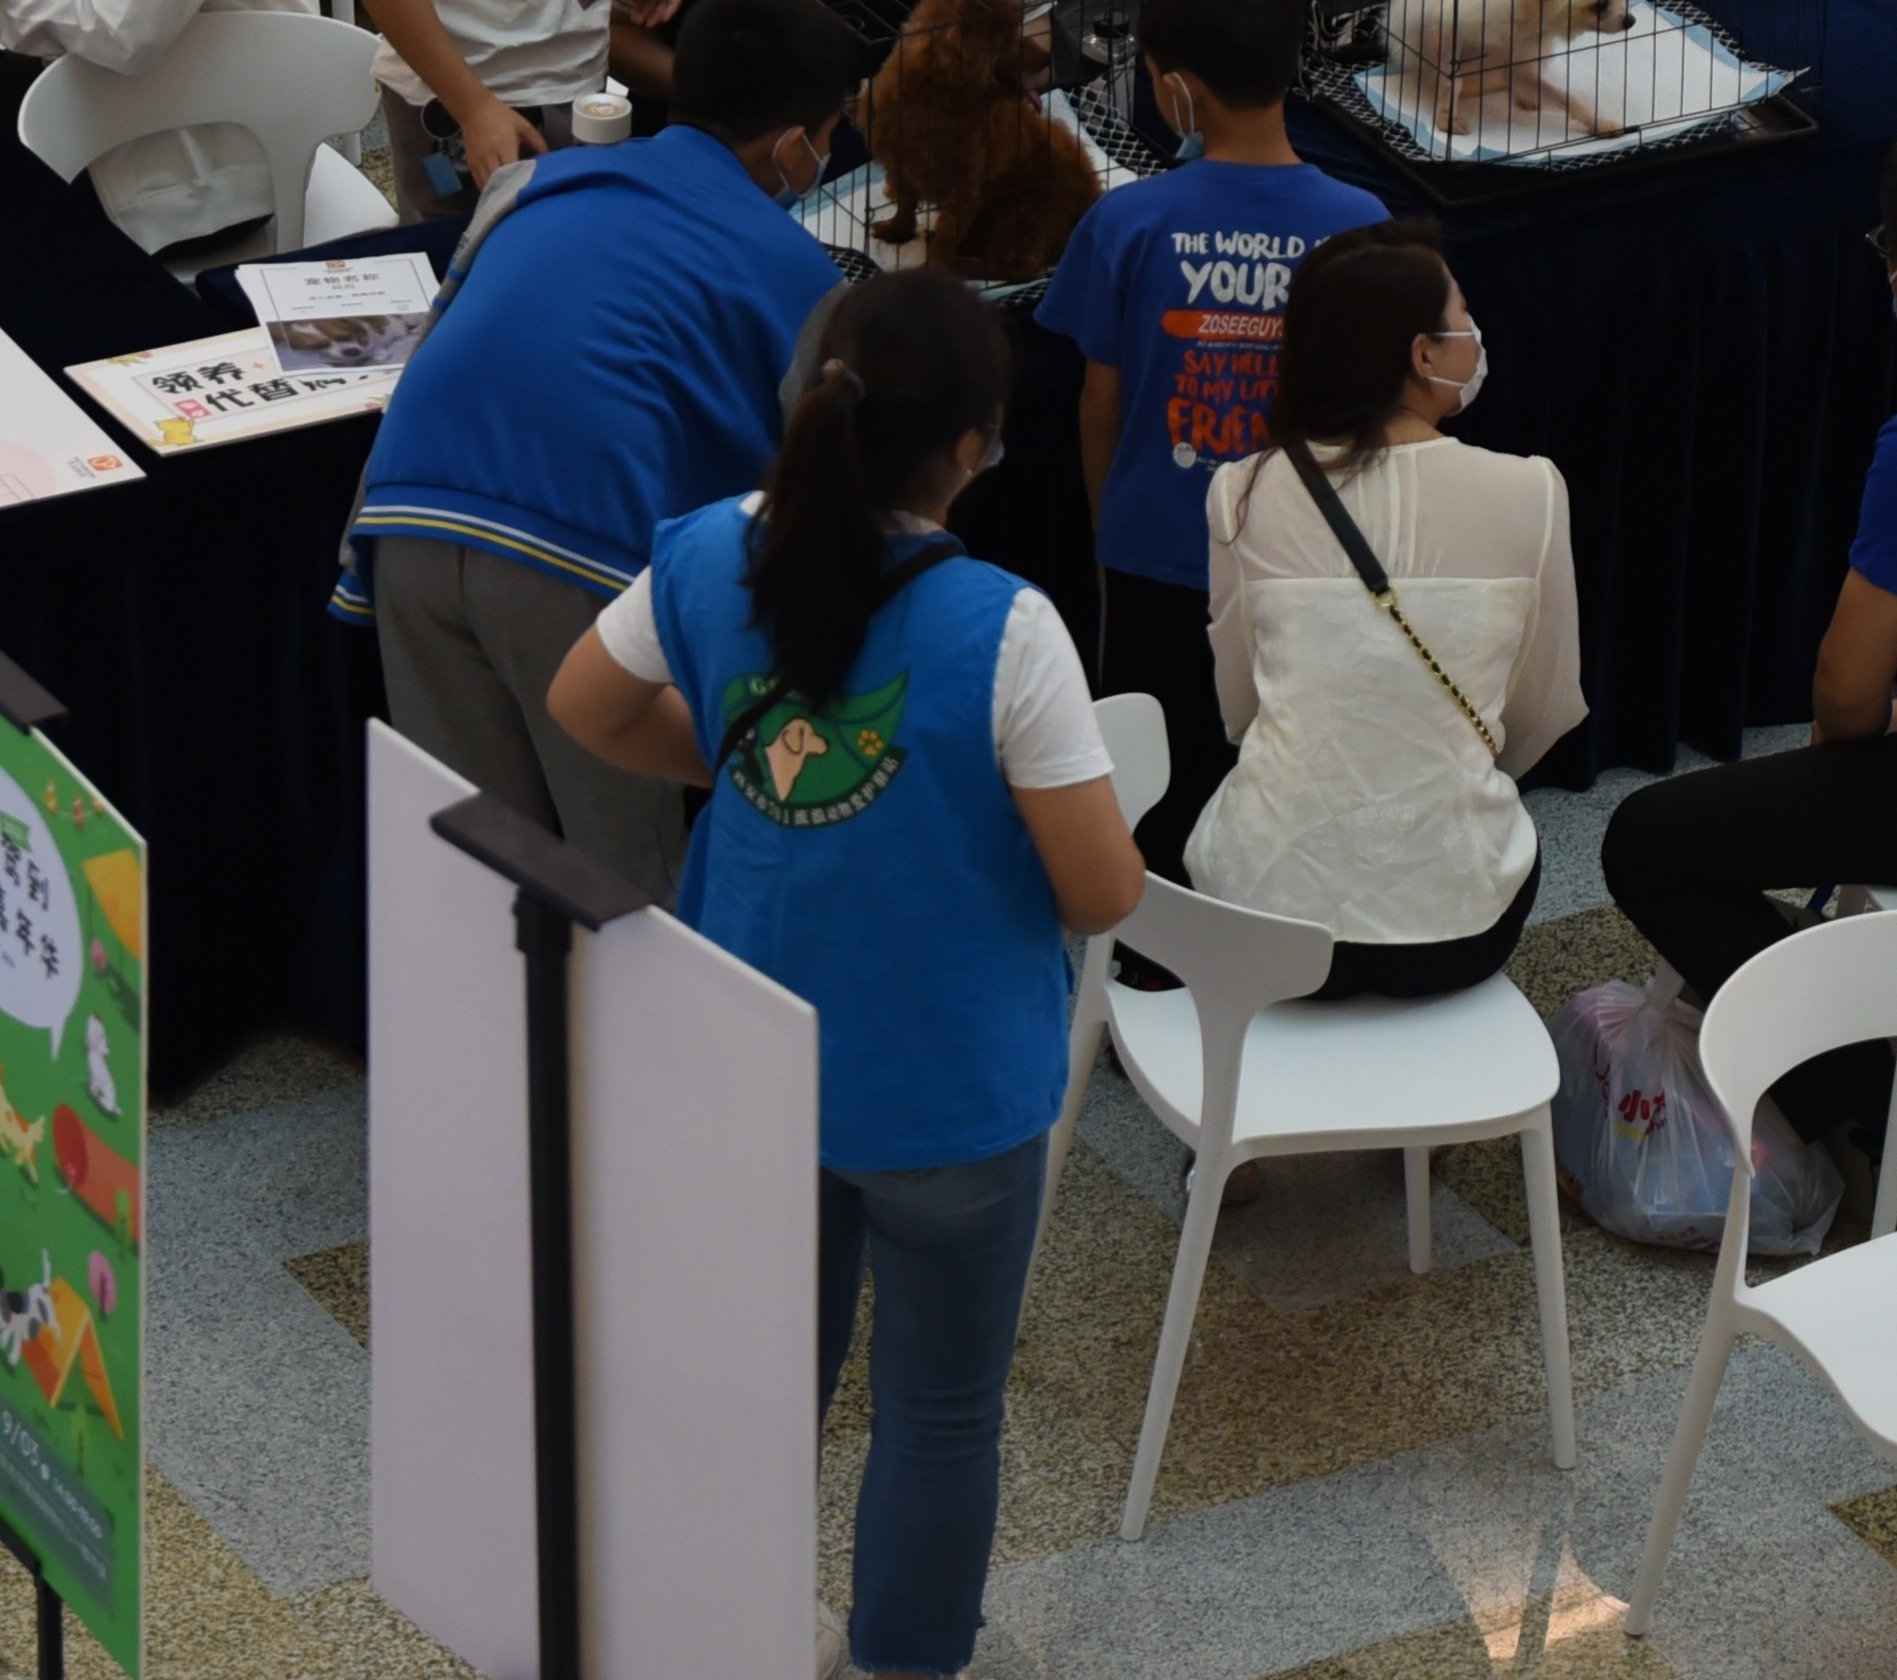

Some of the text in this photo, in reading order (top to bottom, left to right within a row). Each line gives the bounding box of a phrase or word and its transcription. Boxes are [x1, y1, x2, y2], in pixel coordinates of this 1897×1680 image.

[1170, 229, 1307, 260] THE WORLD
[1198, 313, 1286, 337] ZOSEEGUY
[1183, 348, 1280, 376] SAY HELL
[151, 361, 245, 395] 领养
[1174, 373, 1198, 399] TO
[1201, 376, 1235, 405] MY
[1167, 396, 1273, 456] FRIEN
